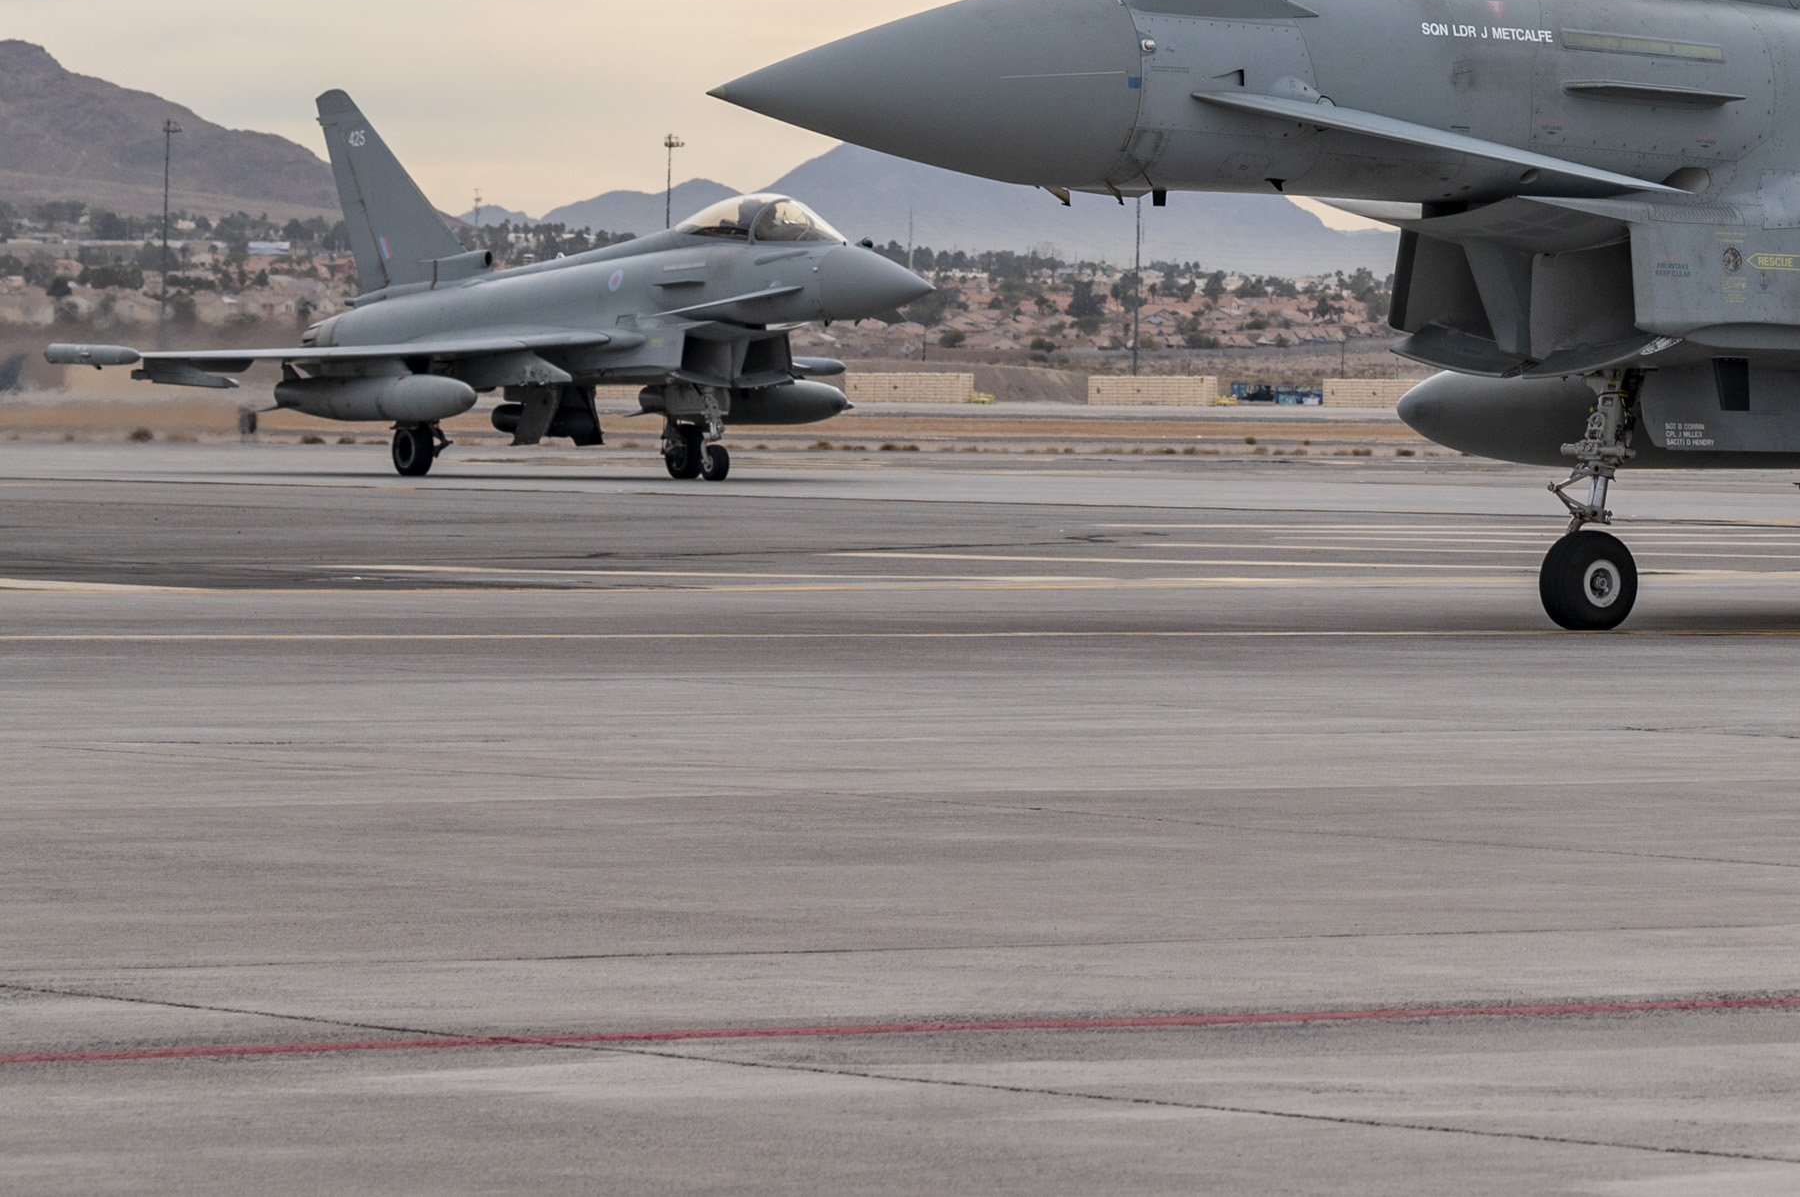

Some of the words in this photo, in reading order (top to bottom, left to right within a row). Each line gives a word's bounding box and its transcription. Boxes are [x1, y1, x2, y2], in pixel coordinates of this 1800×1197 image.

[1421, 22, 1449, 36] SQN
[1452, 24, 1477, 38] LDR
[1481, 26, 1488, 39] J
[1491, 27, 1553, 43] METCALFE
[349, 130, 366, 147] 425
[1757, 256, 1794, 267] RESCUE
[1692, 439, 1715, 447] HENDRY
